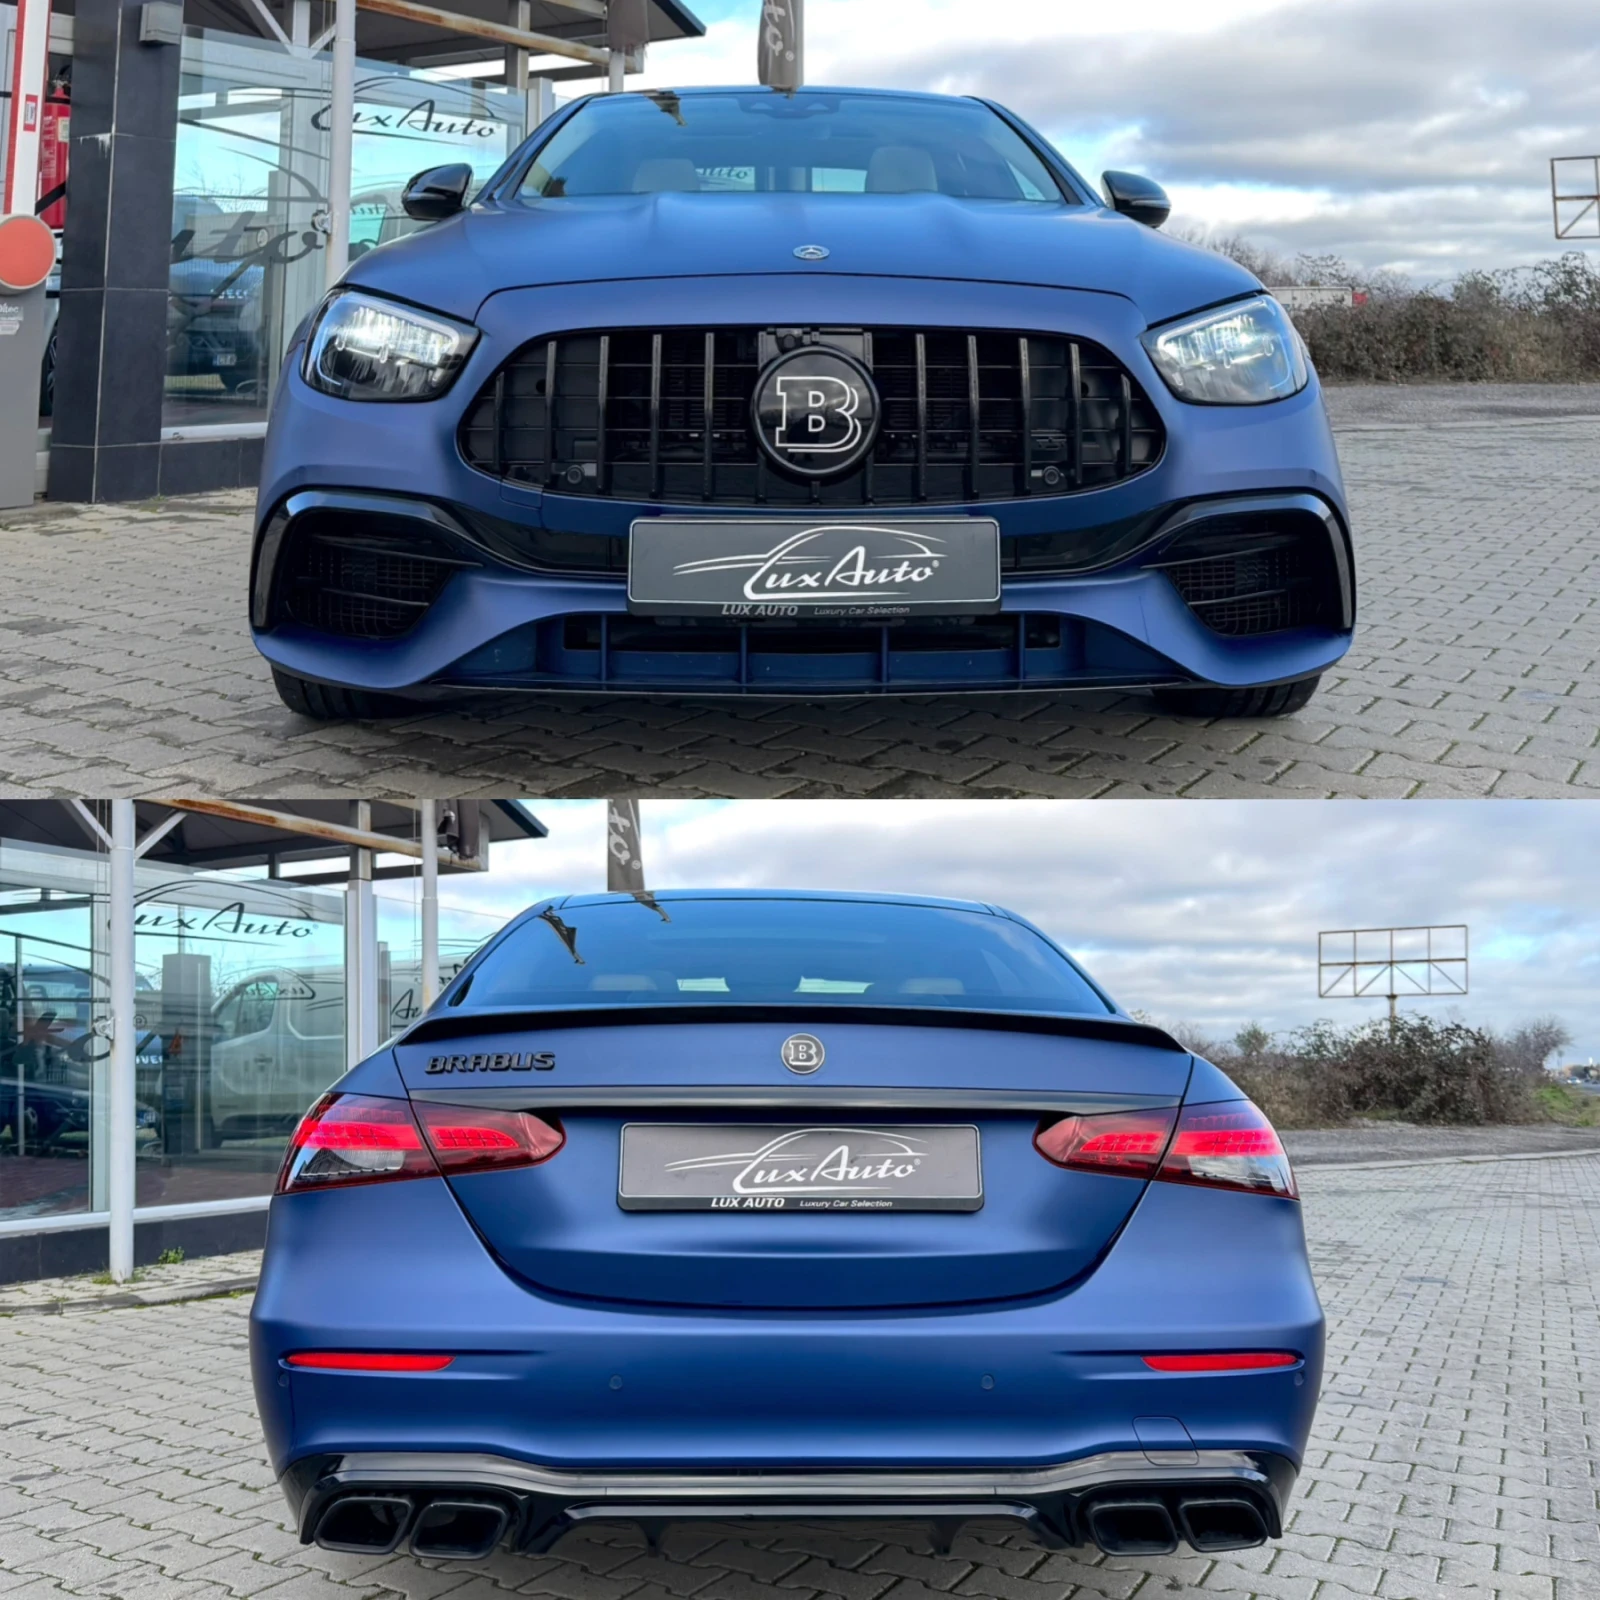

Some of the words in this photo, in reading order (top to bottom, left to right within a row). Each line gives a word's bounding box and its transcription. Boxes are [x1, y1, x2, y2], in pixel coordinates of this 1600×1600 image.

[775, 376, 863, 453] B
[721, 604, 751, 616] LUX
[755, 605, 798, 616] AUTO
[814, 607, 846, 616] Luxury
[849, 607, 865, 615] Car
[867, 605, 910, 616] Selection
[424, 1051, 556, 1075] BRABUS
[788, 1039, 818, 1066] B
[711, 1197, 740, 1208] LUX
[742, 1197, 785, 1208] AUTO
[799, 1200, 831, 1208] Luxury
[832, 1200, 849, 1208] Car
[850, 1200, 893, 1208] Selection
